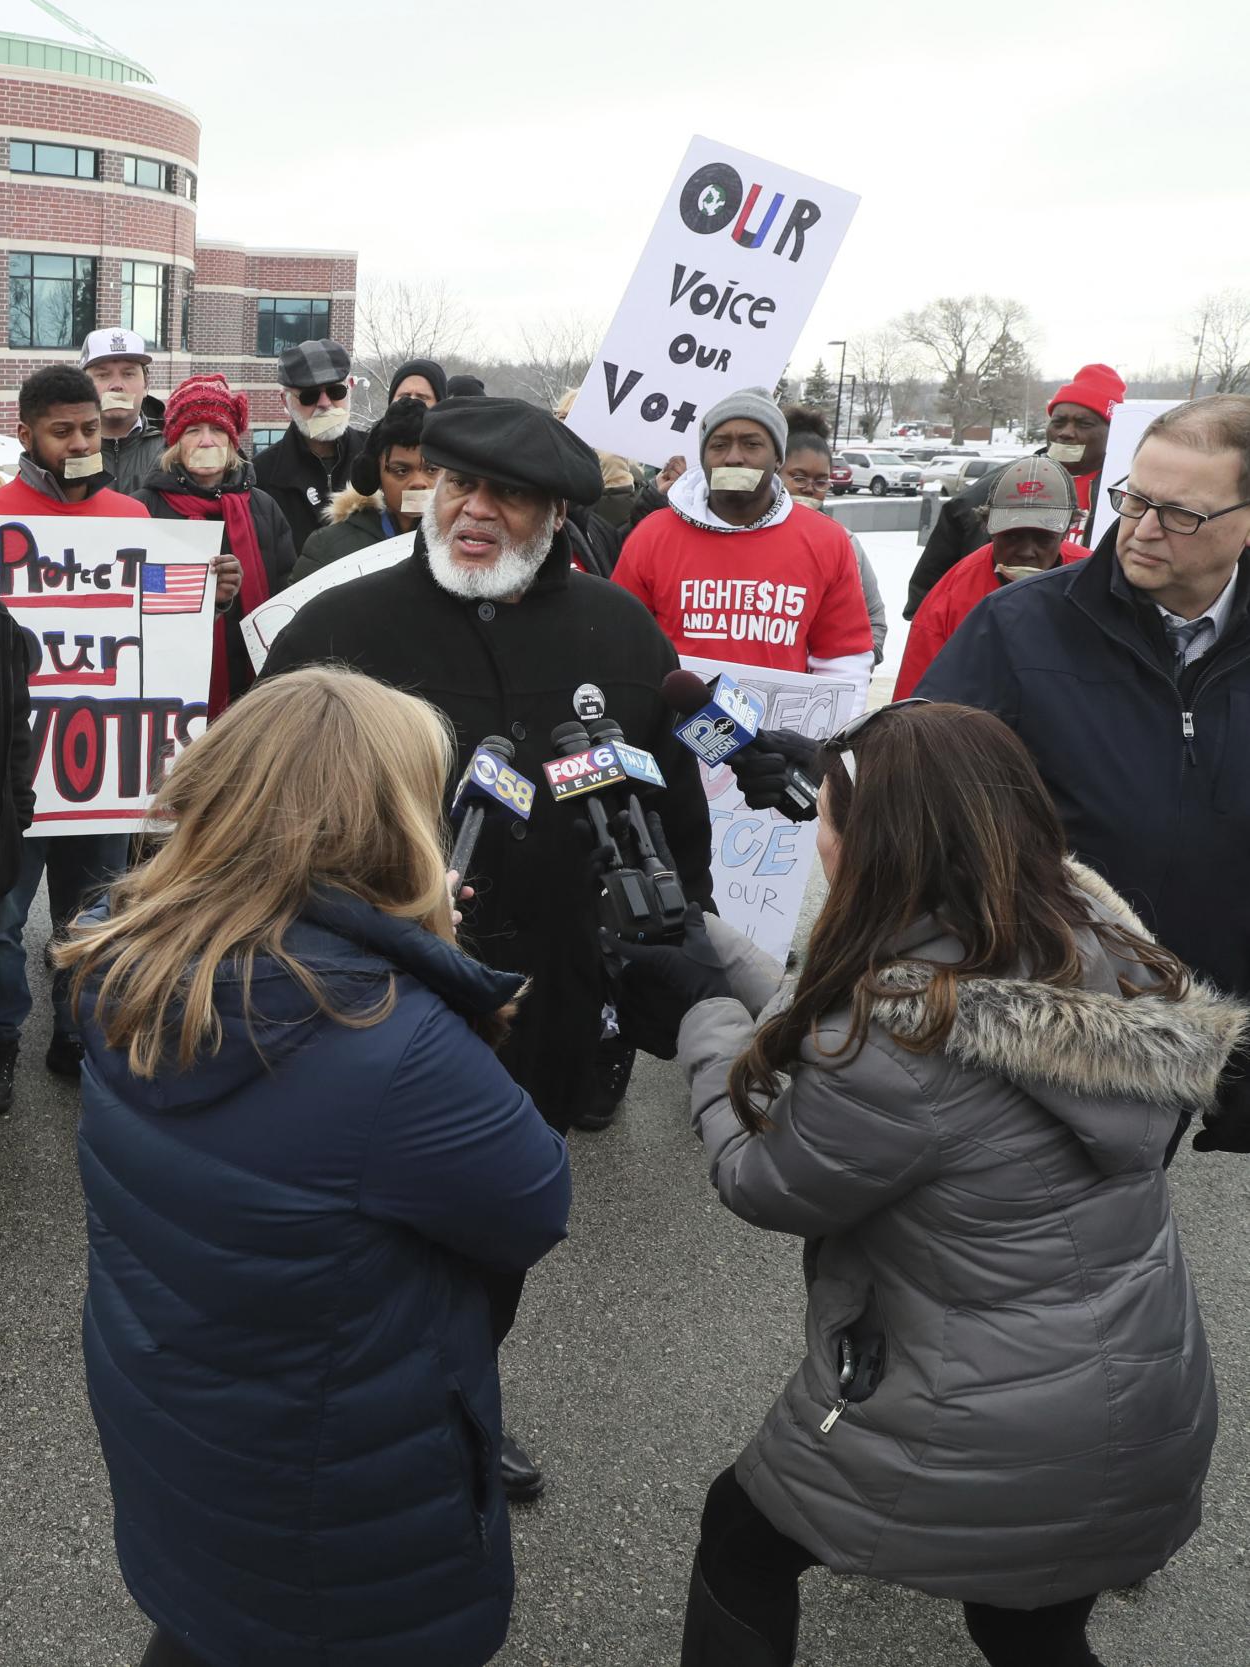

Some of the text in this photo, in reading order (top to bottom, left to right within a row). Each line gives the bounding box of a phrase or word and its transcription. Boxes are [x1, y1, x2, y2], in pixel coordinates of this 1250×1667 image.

[679, 162, 822, 263] OUR
[669, 263, 776, 329] Voice
[668, 333, 732, 373] OUR
[681, 579, 758, 610] FIGHT
[756, 580, 807, 617] $15
[683, 613, 800, 646] AND A UNION
[715, 719, 733, 733] abc
[738, 679, 855, 741] TECT
[548, 753, 594, 782] FOX
[594, 747, 614, 767] 6
[705, 738, 736, 761] WISN
[495, 768, 532, 812] 58
[556, 767, 619, 794] NEWS
[728, 881, 784, 915] OUR
